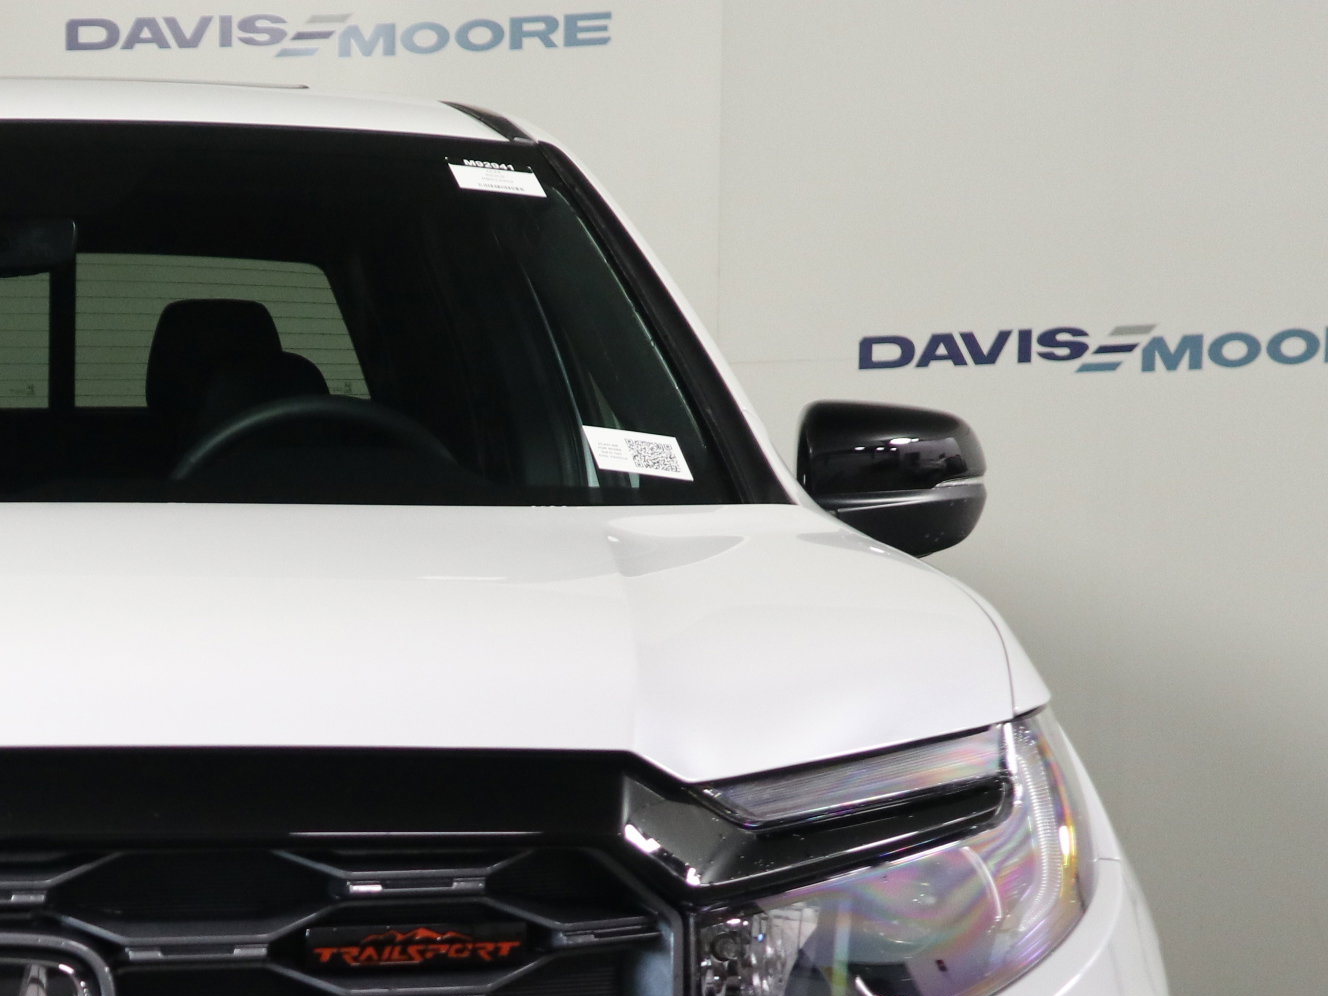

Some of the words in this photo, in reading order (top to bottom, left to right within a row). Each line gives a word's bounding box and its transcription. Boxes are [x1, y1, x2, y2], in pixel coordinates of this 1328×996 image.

[65, 15, 288, 51] DAVIS
[338, 12, 612, 58] MOORE
[859, 327, 1090, 369] DAVIS
[1141, 328, 1328, 372] MOO
[313, 941, 520, 966] TRAILSPORT
